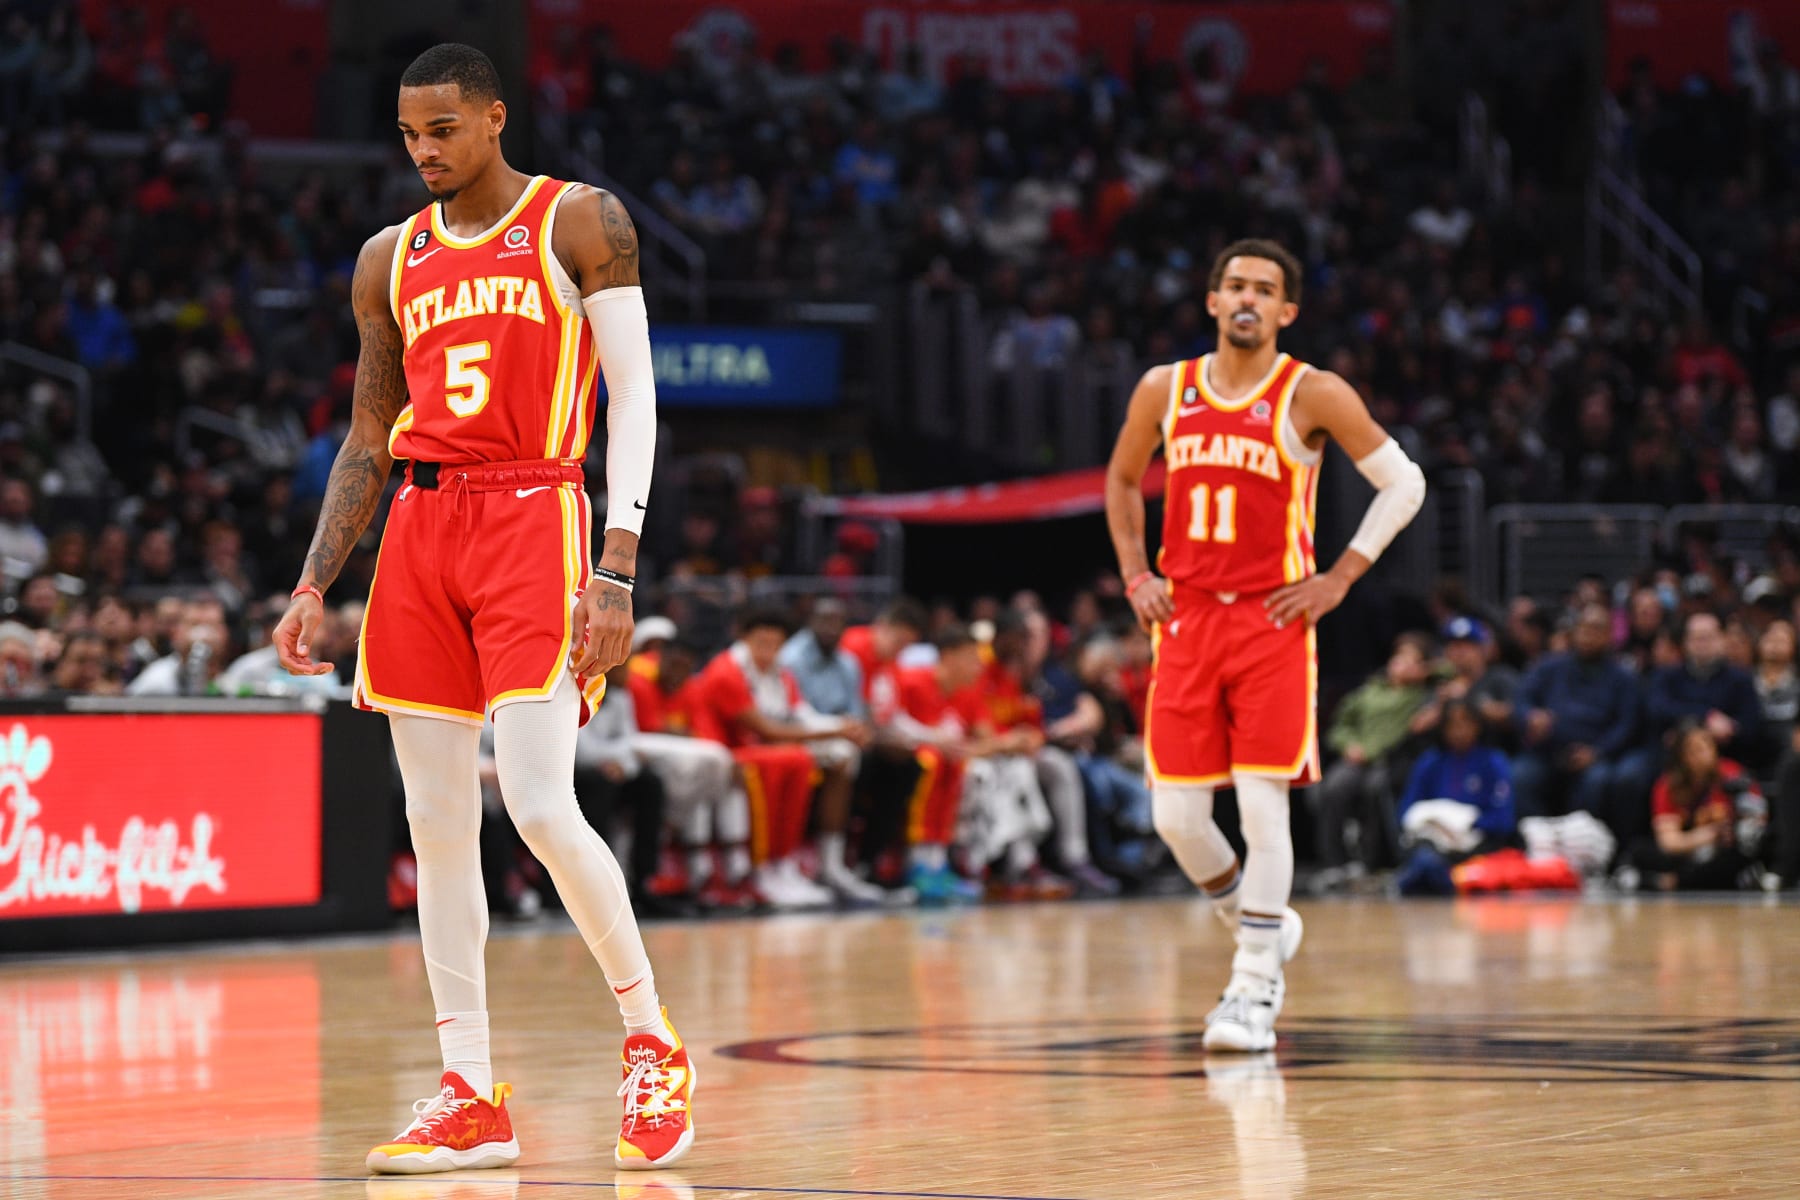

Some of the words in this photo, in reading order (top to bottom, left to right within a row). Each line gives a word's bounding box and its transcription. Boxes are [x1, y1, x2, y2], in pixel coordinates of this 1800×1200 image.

[414, 232, 427, 249] 6
[496, 248, 533, 259] sharecare
[403, 275, 546, 350] ATLANTA
[444, 340, 491, 419] 5
[1168, 433, 1281, 481] ATLANTA
[1188, 482, 1237, 543] 11
